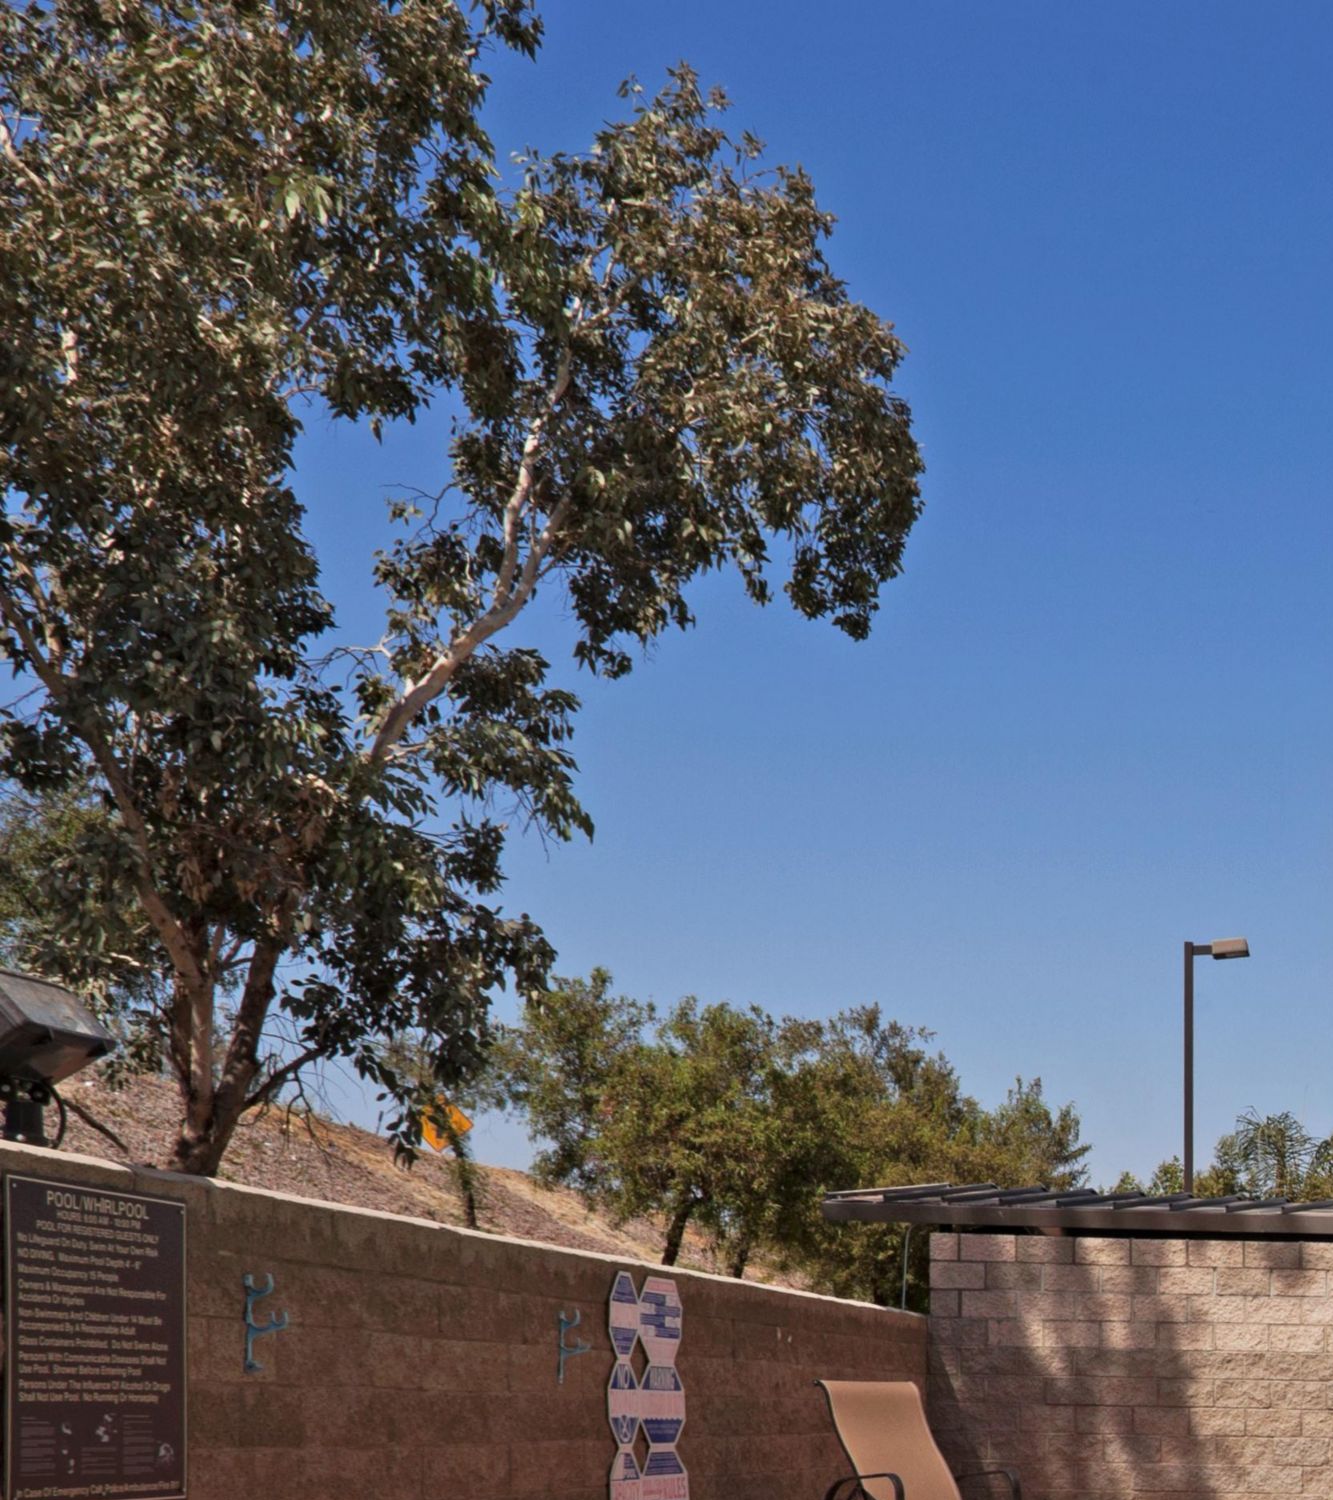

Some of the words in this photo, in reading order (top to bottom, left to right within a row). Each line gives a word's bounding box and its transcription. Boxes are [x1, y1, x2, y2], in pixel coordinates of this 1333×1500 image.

[46, 1190, 150, 1220] POOL/WHIRLPOOL
[36, 1220, 56, 1232] POOL
[57, 1223, 71, 1233] FOR
[73, 1225, 113, 1239] REGISTERED
[116, 1231, 141, 1242] GUESTS
[143, 1234, 159, 1245] ONLY
[29, 1234, 60, 1249] Lifeguard
[90, 1242, 106, 1252] Swim
[116, 1245, 129, 1255] Your
[130, 1247, 144, 1257] Own
[59, 1253, 89, 1264] Maximum
[90, 1256, 104, 1266] Pool
[106, 1258, 124, 1270] Depth
[18, 1264, 50, 1276] Maximum
[52, 1268, 88, 1281] Occupancy
[97, 1272, 119, 1284] People
[18, 1280, 45, 1290] Owners
[52, 1283, 93, 1296] Management
[95, 1287, 105, 1295] Are
[107, 1288, 118, 1296] Not
[119, 1289, 155, 1301] Responsible
[156, 1292, 166, 1301] For
[18, 1293, 51, 1303] Accidents
[62, 1296, 85, 1307] Injuries
[70, 1312, 83, 1321] And
[85, 1313, 109, 1322] Children
[111, 1315, 129, 1324] Under
[138, 1317, 152, 1325] Must
[19, 1321, 64, 1333] Accompanied
[81, 1325, 119, 1336] Responsible
[120, 1327, 135, 1335] Adult
[19, 1336, 38, 1345] Glass
[39, 1337, 74, 1347] Containers
[122, 1342, 133, 1350] Not
[134, 1342, 150, 1351] Swim
[152, 1343, 168, 1351] Alone
[19, 1352, 46, 1361] Persons
[48, 1354, 62, 1362] With
[64, 1354, 110, 1363] Communicable
[112, 1356, 139, 1365] Diseases
[141, 1357, 155, 1365] Shall
[156, 1358, 167, 1366] Not
[19, 1364, 32, 1373] Use
[53, 1366, 77, 1374] Shower
[79, 1366, 99, 1375] Before
[101, 1367, 127, 1377] Entering
[19, 1380, 46, 1389] Persons
[48, 1381, 67, 1389] Under
[69, 1381, 81, 1390] The
[83, 1382, 111, 1390] Influence
[121, 1383, 143, 1391] Alcohol
[153, 1383, 171, 1393] Drugs
[19, 1393, 36, 1402] Shall
[37, 1393, 48, 1402] Not
[50, 1393, 63, 1402] Use
[94, 1394, 119, 1404] Running
[128, 1395, 159, 1405] Horseplay
[24, 1488, 42, 1498] Case
[53, 1486, 89, 1498] Emergency
